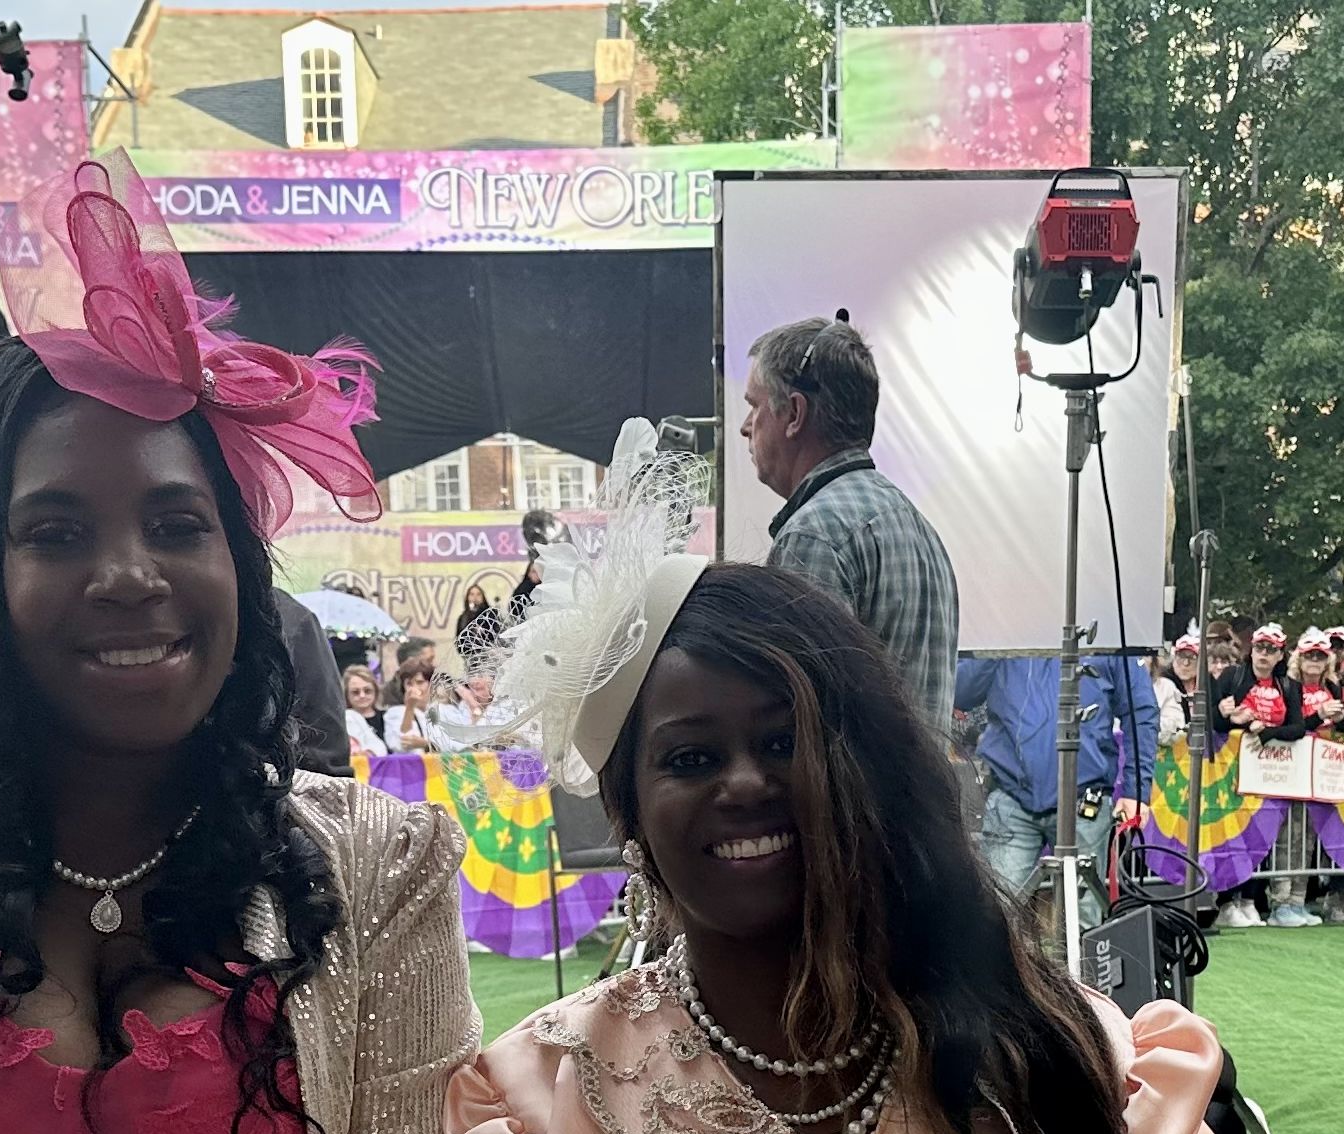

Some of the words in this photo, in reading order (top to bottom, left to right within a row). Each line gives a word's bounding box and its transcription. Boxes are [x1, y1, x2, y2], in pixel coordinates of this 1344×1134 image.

[143, 184, 242, 216] HODA
[246, 185, 269, 216] &
[273, 184, 392, 216] JENNA
[421, 166, 568, 228] NEW
[413, 531, 494, 557] HODA
[497, 532, 516, 555] &
